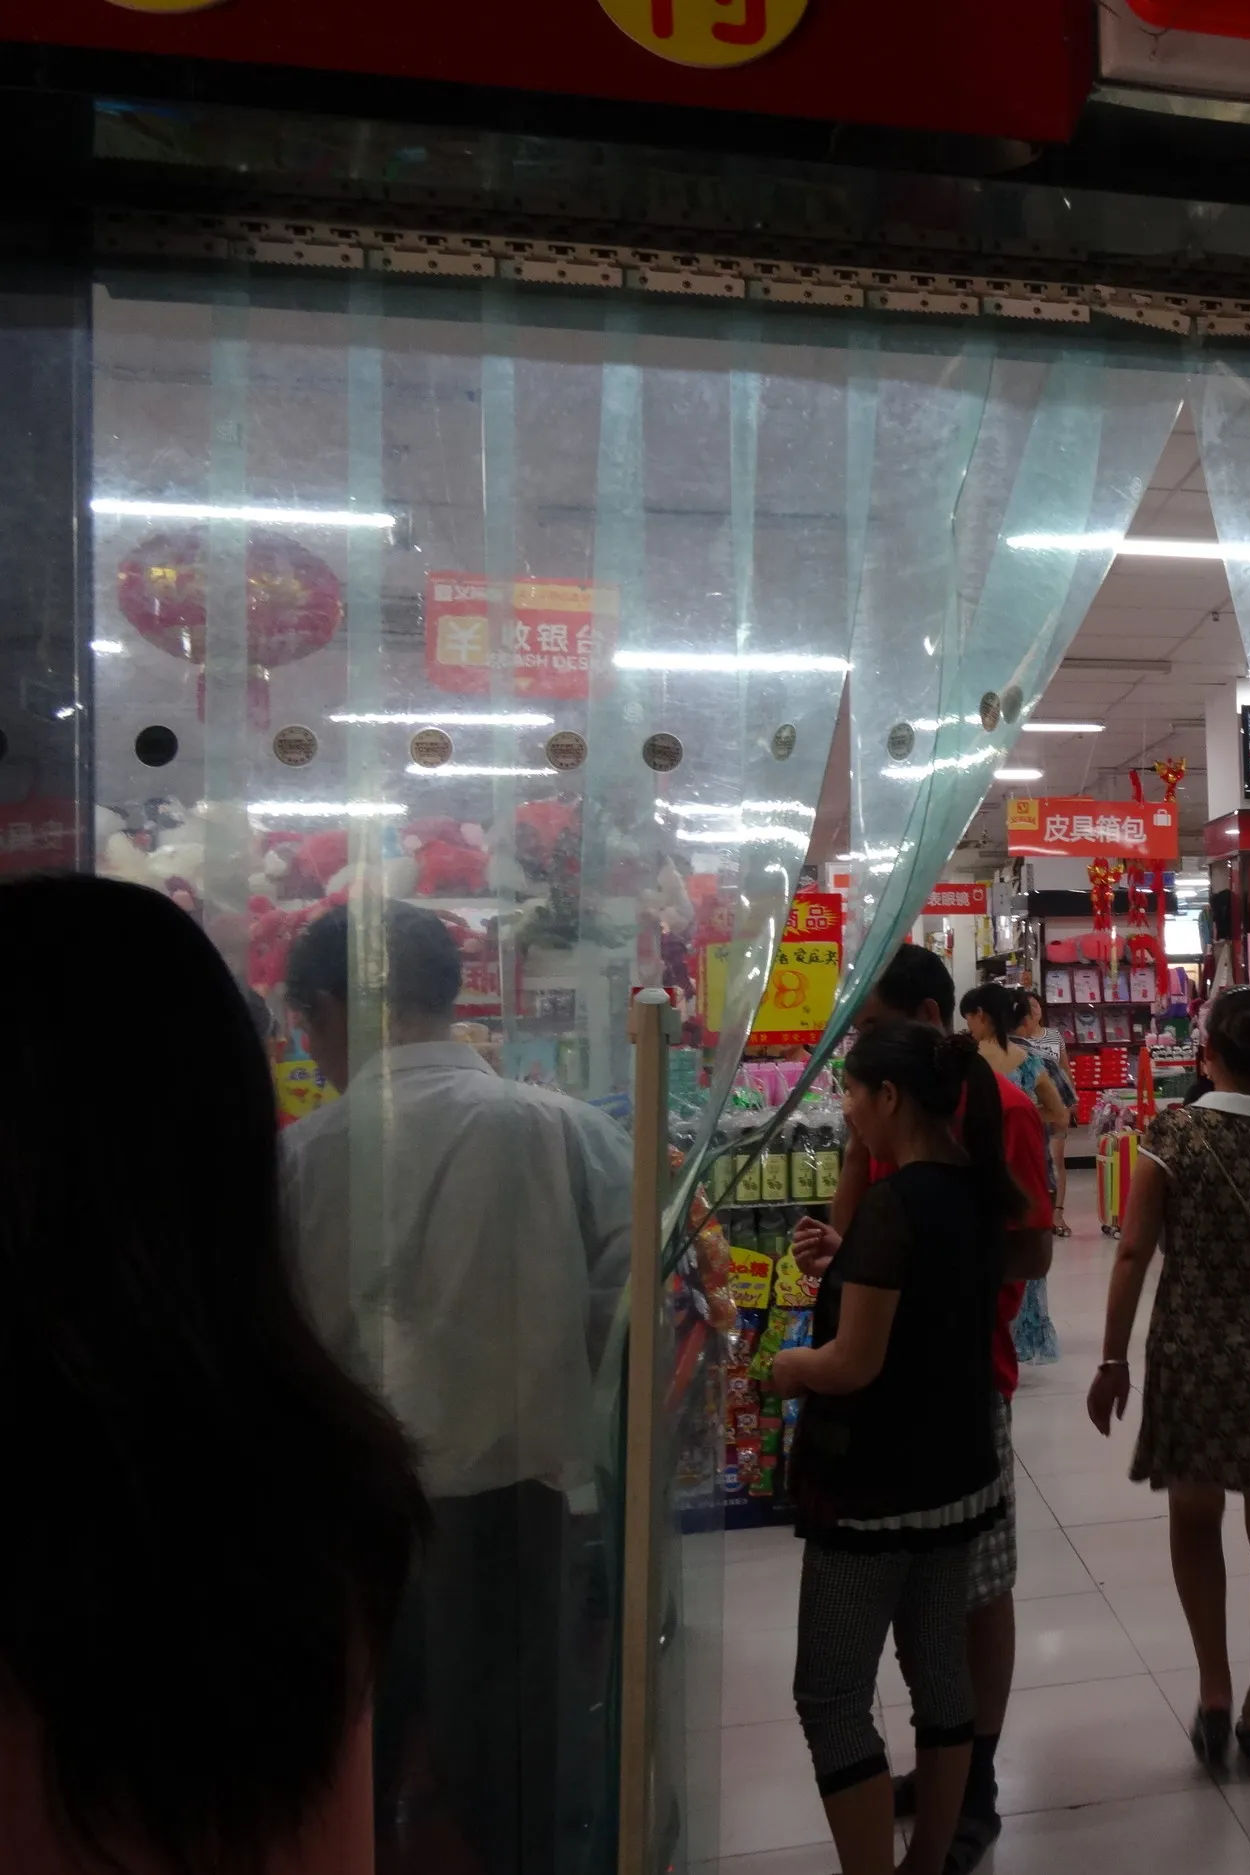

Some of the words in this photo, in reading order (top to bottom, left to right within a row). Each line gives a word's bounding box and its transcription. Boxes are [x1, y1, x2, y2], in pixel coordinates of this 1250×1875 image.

[501, 620, 605, 655] 收银台
[1043, 813, 1148, 844] 皮具箱包
